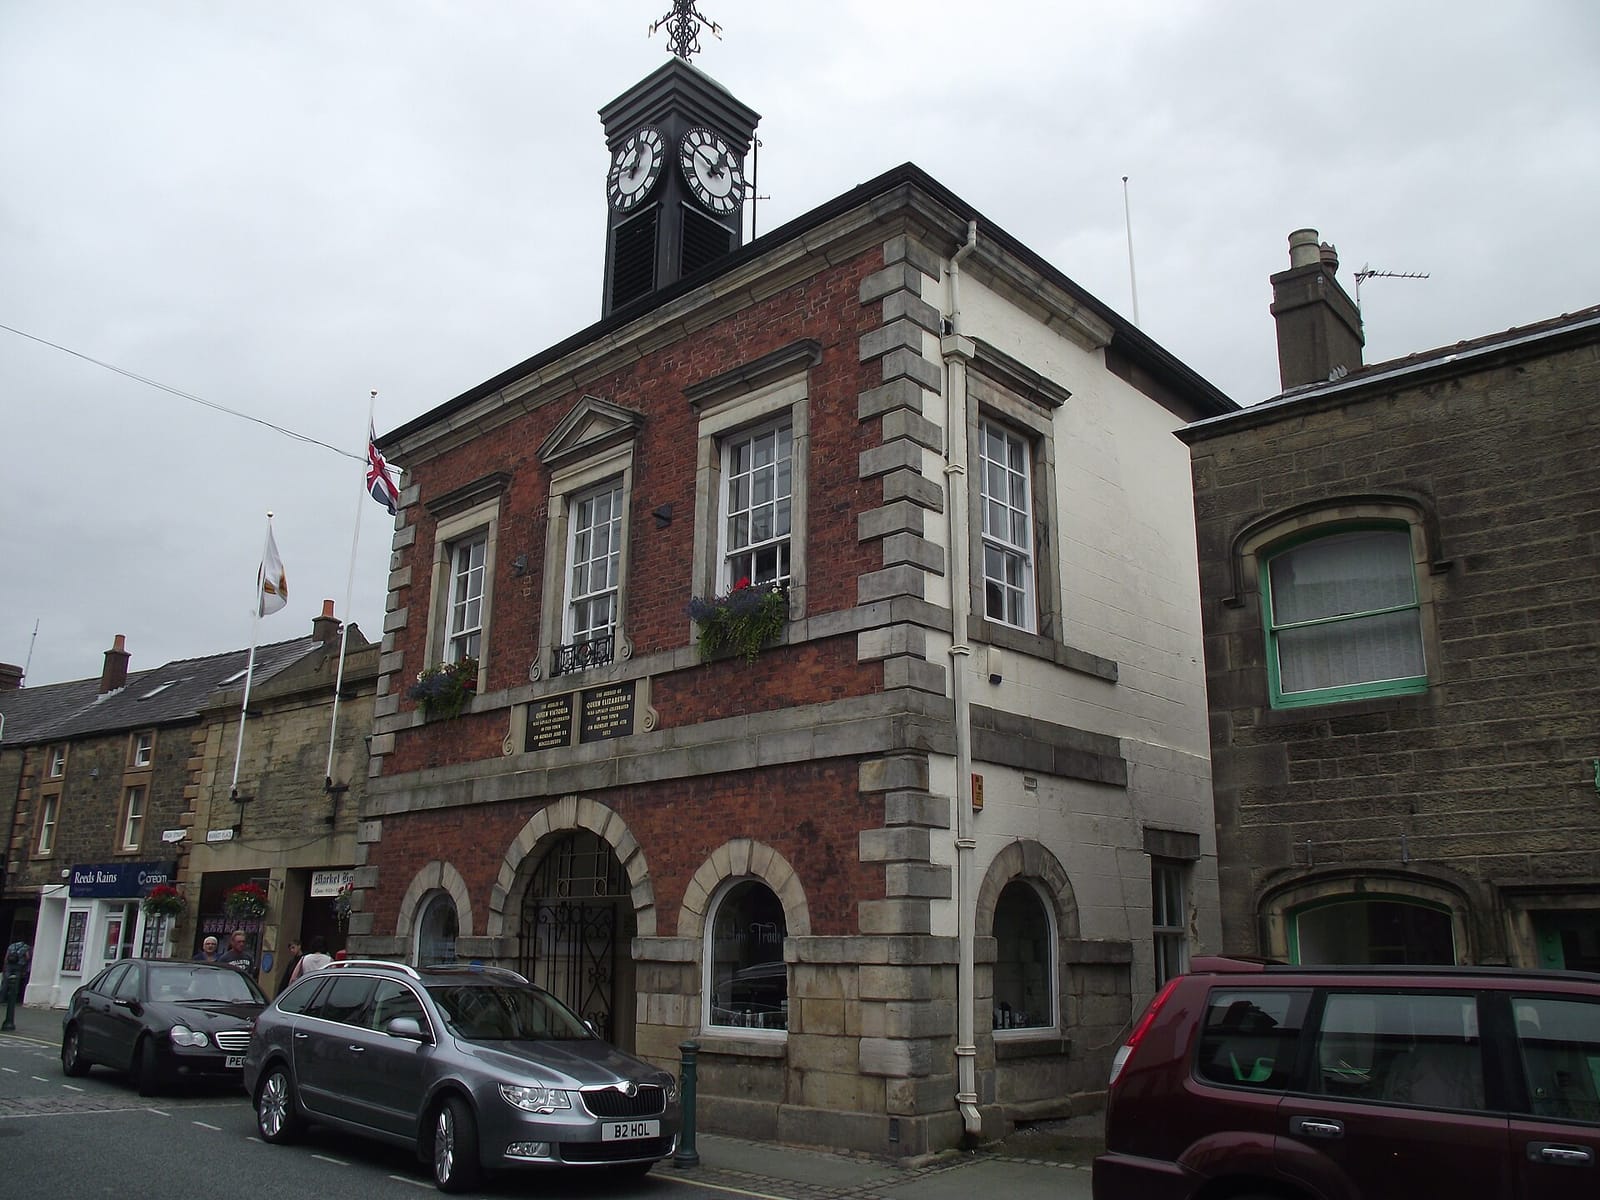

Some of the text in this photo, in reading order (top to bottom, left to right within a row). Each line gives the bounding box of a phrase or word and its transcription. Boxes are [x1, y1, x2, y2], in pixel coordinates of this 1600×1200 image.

[586, 700, 601, 709] QUEEN
[602, 695, 626, 706] ELIZABETH
[535, 707, 568, 719] QUEEN VICTORIA
[74, 870, 118, 884] Reeds Rains
[315, 873, 340, 885] Market
[615, 1122, 650, 1138] B2 HOL
